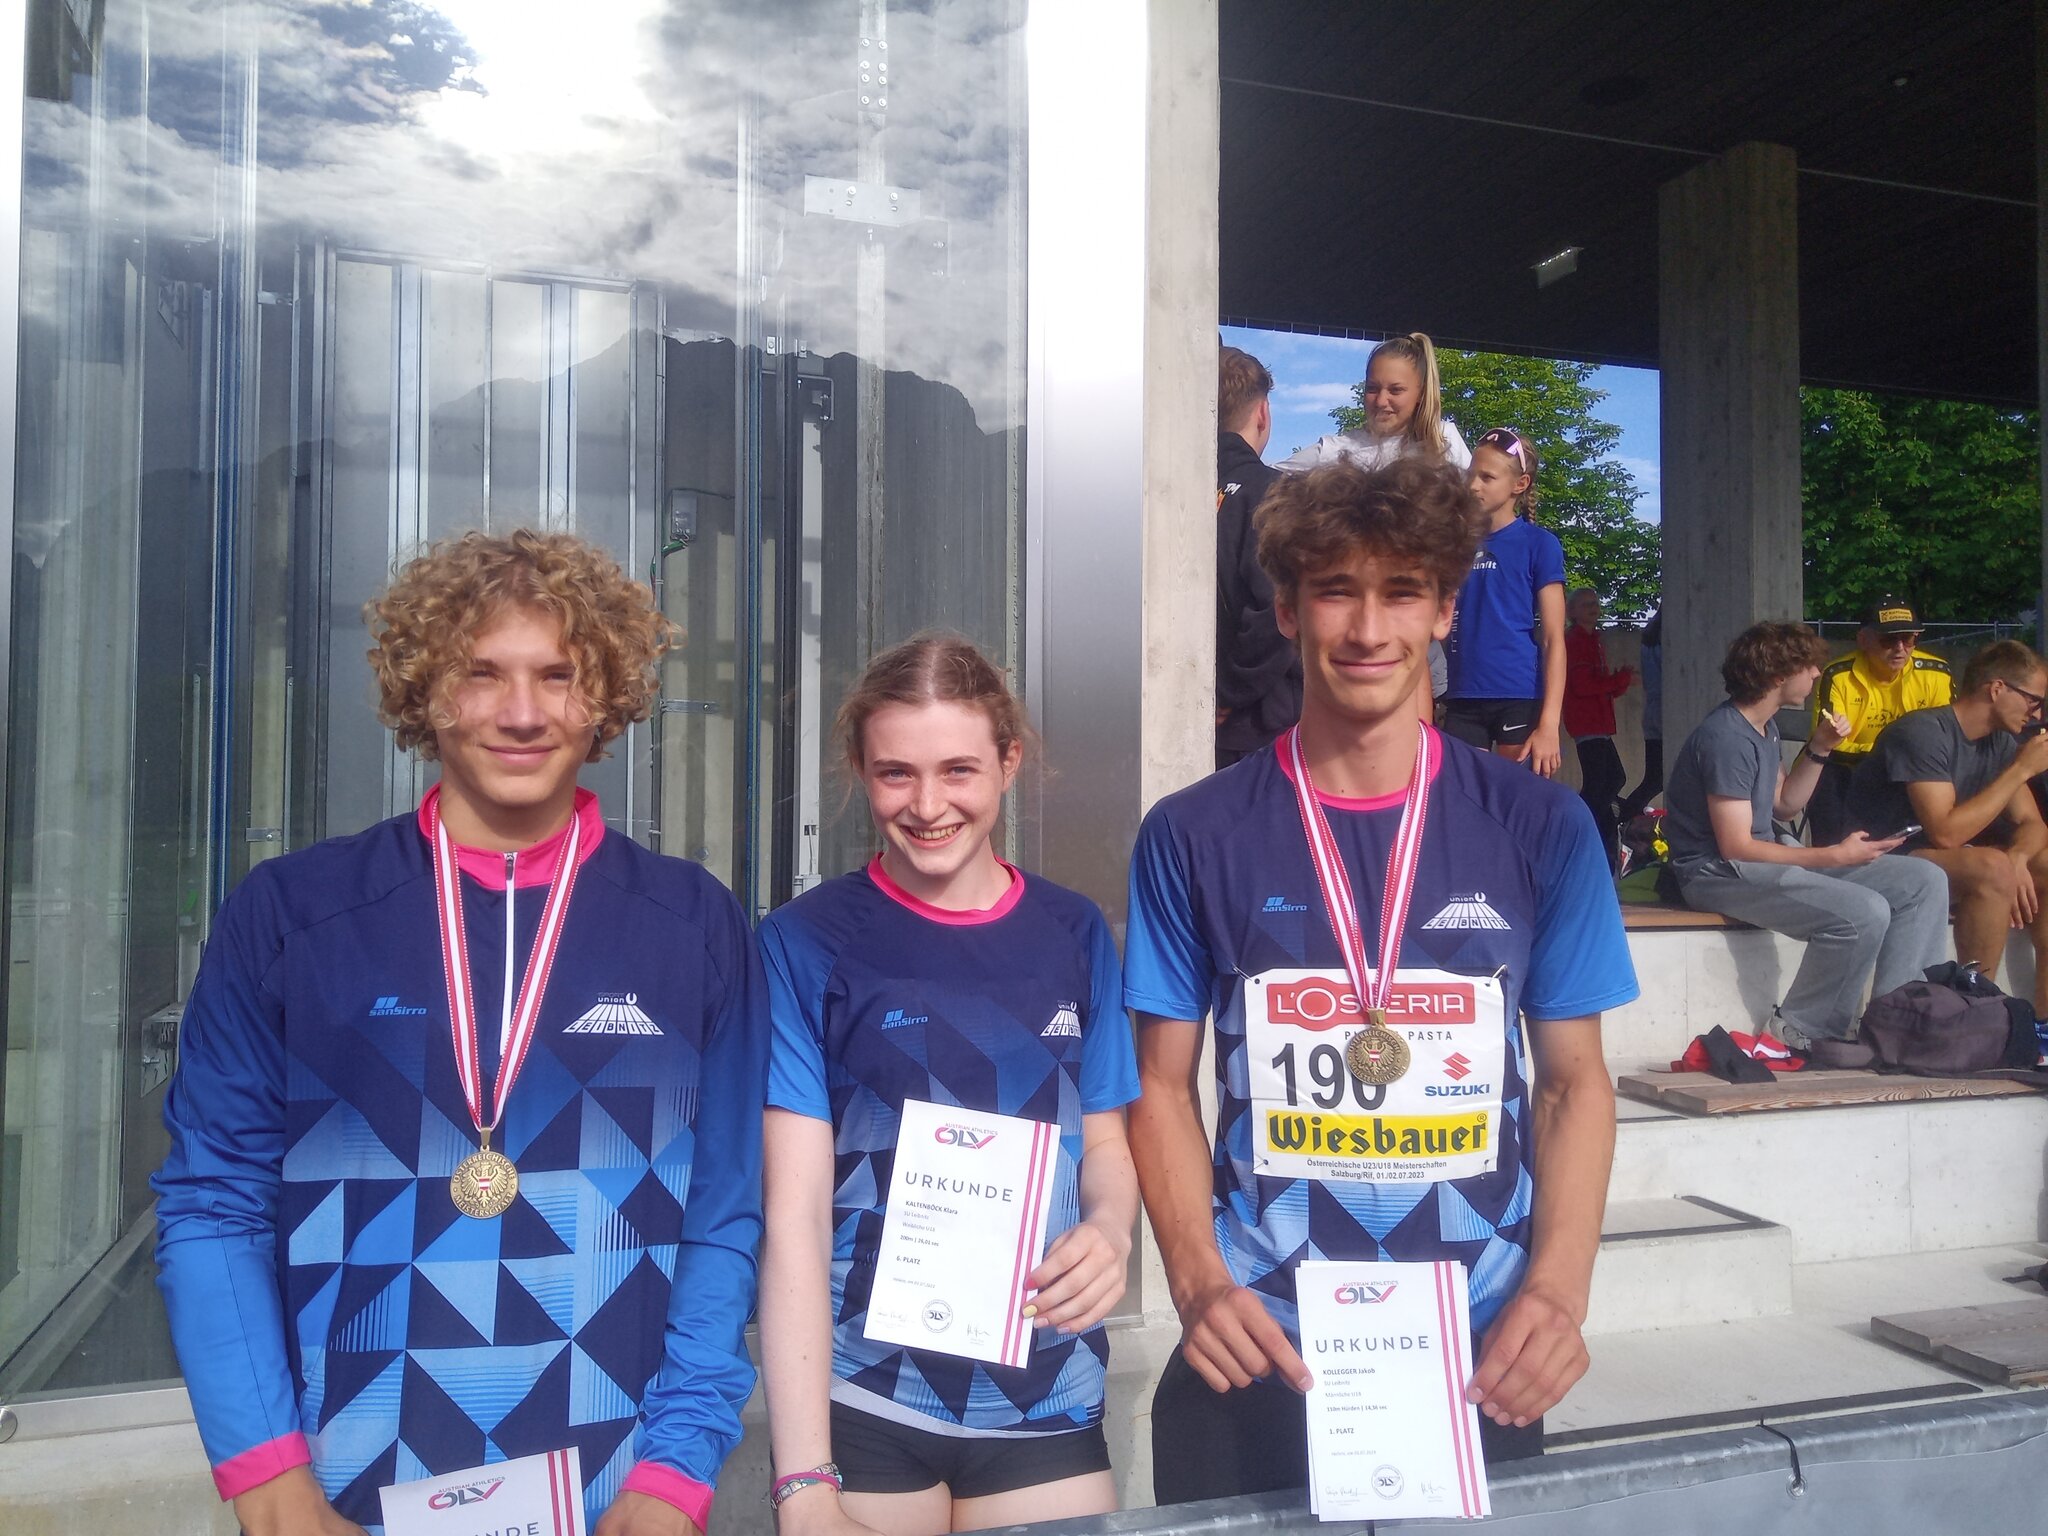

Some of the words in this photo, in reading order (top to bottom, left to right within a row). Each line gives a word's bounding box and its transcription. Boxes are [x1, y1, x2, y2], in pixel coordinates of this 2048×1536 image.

[1262, 904, 1307, 913] sanSirro
[1425, 918, 1509, 928] LEIBNITZ
[1277, 987, 1464, 1021] L'OSERIA
[368, 1006, 427, 1016] sanSirro
[566, 1021, 660, 1034] LEIBNITZ
[881, 1015, 928, 1030] sanSirro
[1408, 1031, 1453, 1041] PASTA
[1424, 1084, 1490, 1097] SUZUKI
[945, 1122, 970, 1130] AUSTRIAN
[971, 1127, 998, 1136] ATHLETICS
[453, 1153, 515, 1183] ÖSTERREICHISCHE
[1307, 1158, 1361, 1169] Österreichische
[1362, 1162, 1391, 1170] U23/U18
[1393, 1161, 1447, 1169] Meisterschaften
[1331, 1170, 1375, 1179] Salzburg/Rif,
[1376, 1171, 1425, 1179] 01./02.07.2023
[905, 1171, 1014, 1203] URKUNDE
[454, 1192, 513, 1217] MEISTERSCHAFT
[905, 1200, 943, 1212] KALTENBÖCK
[943, 1207, 958, 1215] Klara
[902, 1256, 921, 1265] PLATZ
[1315, 1335, 1430, 1354] URKUNDE
[1322, 1368, 1357, 1376] KOLLEGGER
[1358, 1367, 1376, 1375] Jakob
[438, 1483, 470, 1493] AUSTRIAN
[471, 1476, 506, 1486] ATHLETICS
